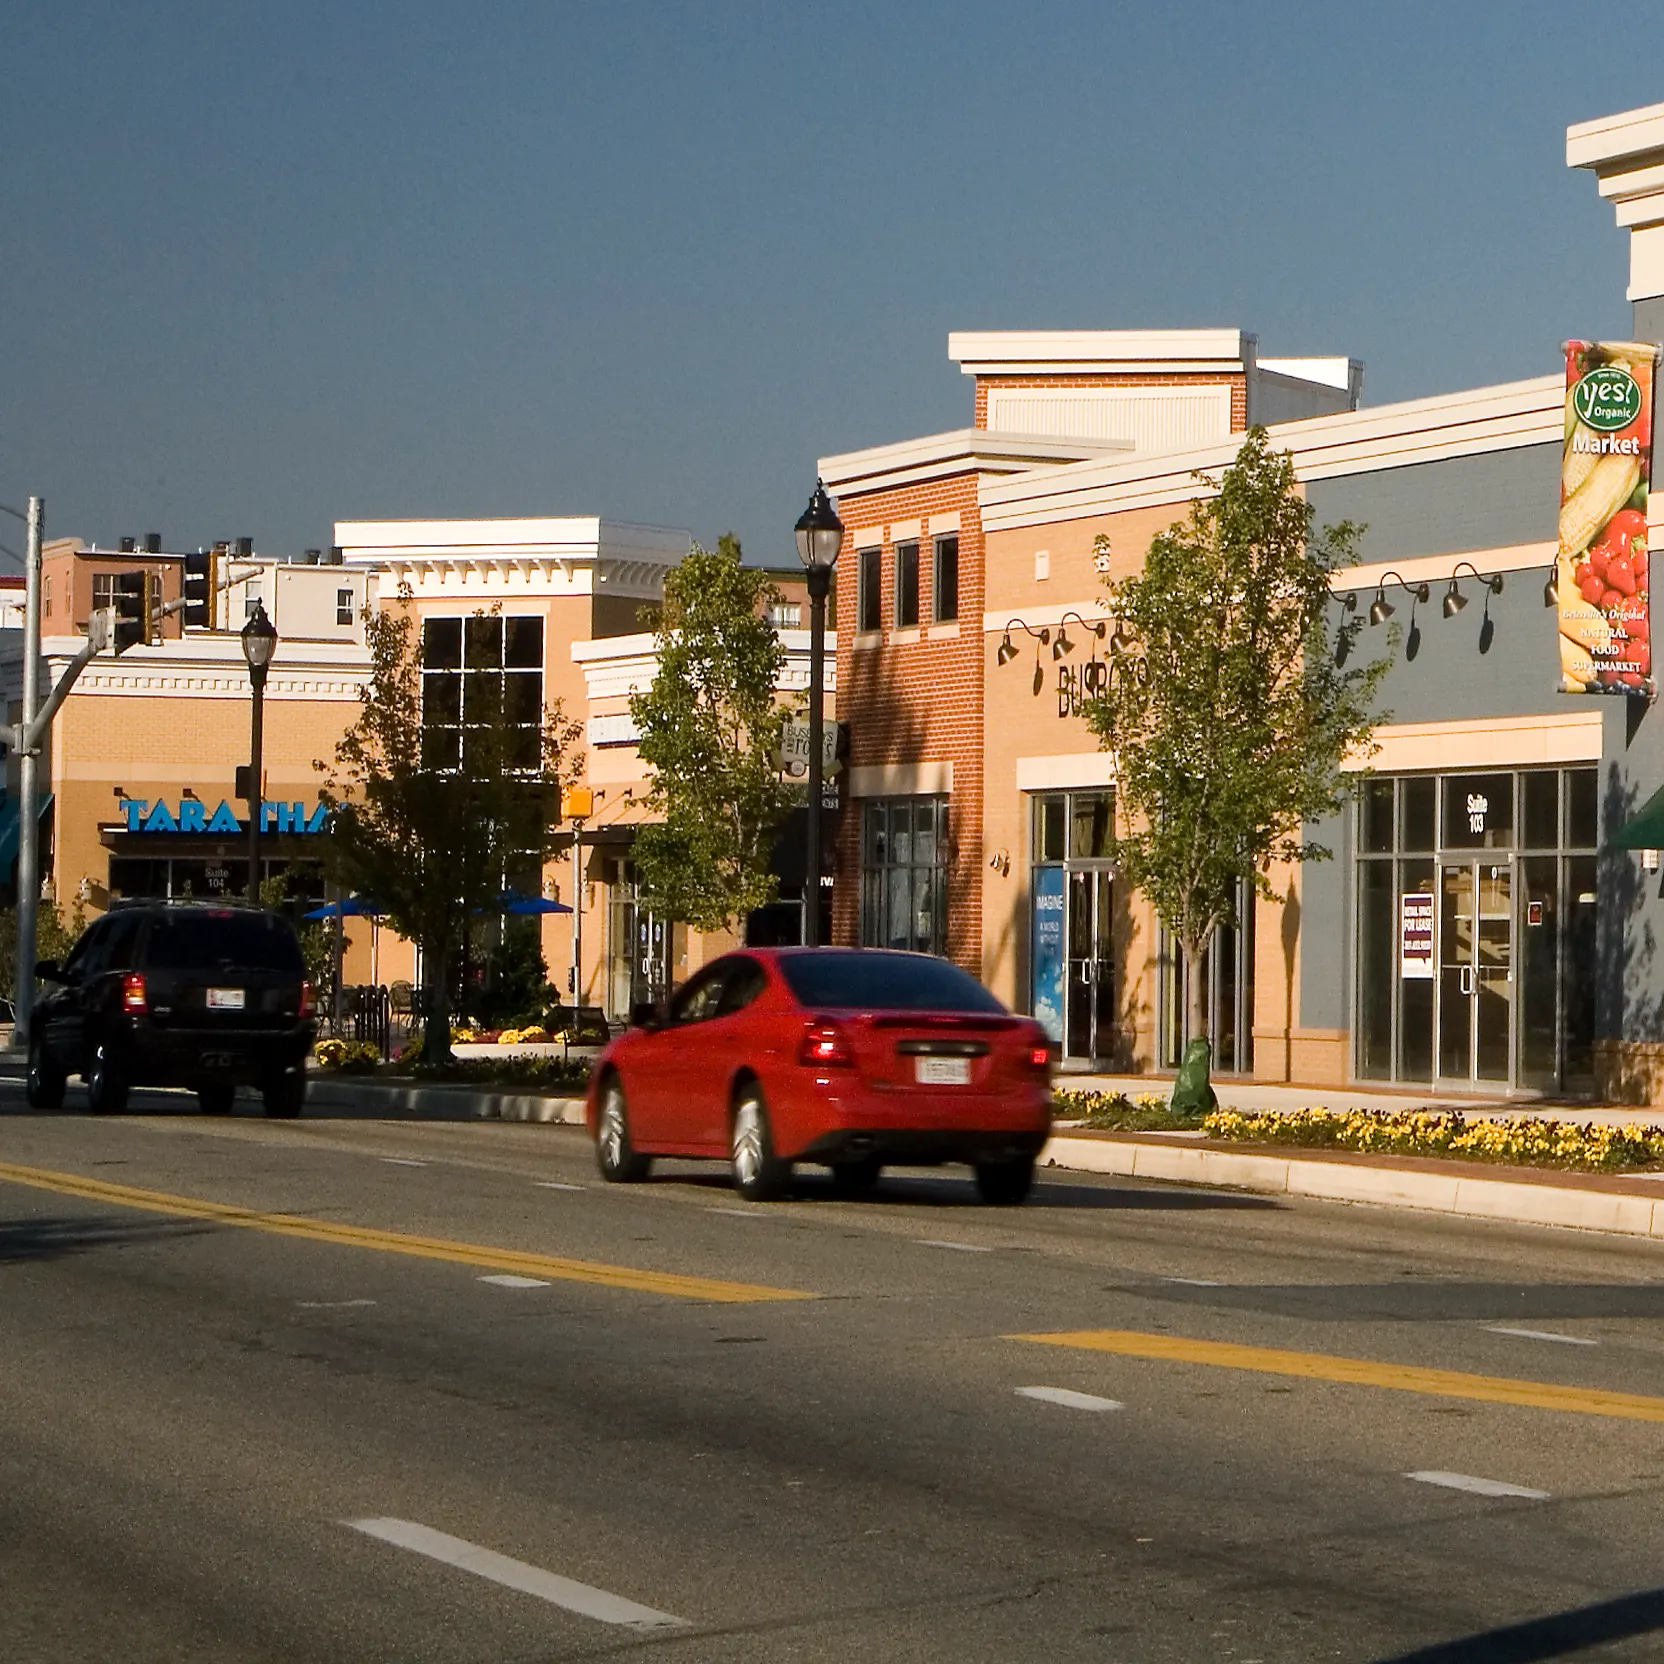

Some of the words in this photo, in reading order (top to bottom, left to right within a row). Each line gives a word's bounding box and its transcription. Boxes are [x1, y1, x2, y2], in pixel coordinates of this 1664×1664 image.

[1582, 380, 1634, 419] yes!
[1594, 405, 1631, 420] Organic
[1572, 432, 1640, 455] Market
[1608, 607, 1646, 622] Original
[1580, 627, 1629, 639] NATURAL
[1591, 644, 1620, 655] FOOD
[1572, 660, 1642, 672] SUPERMARKET
[1466, 793, 1488, 814] Suite
[120, 798, 242, 833] TARA
[259, 800, 349, 833] THA
[1469, 814, 1484, 834] 103
[1036, 895, 1063, 910] IMAGINE
